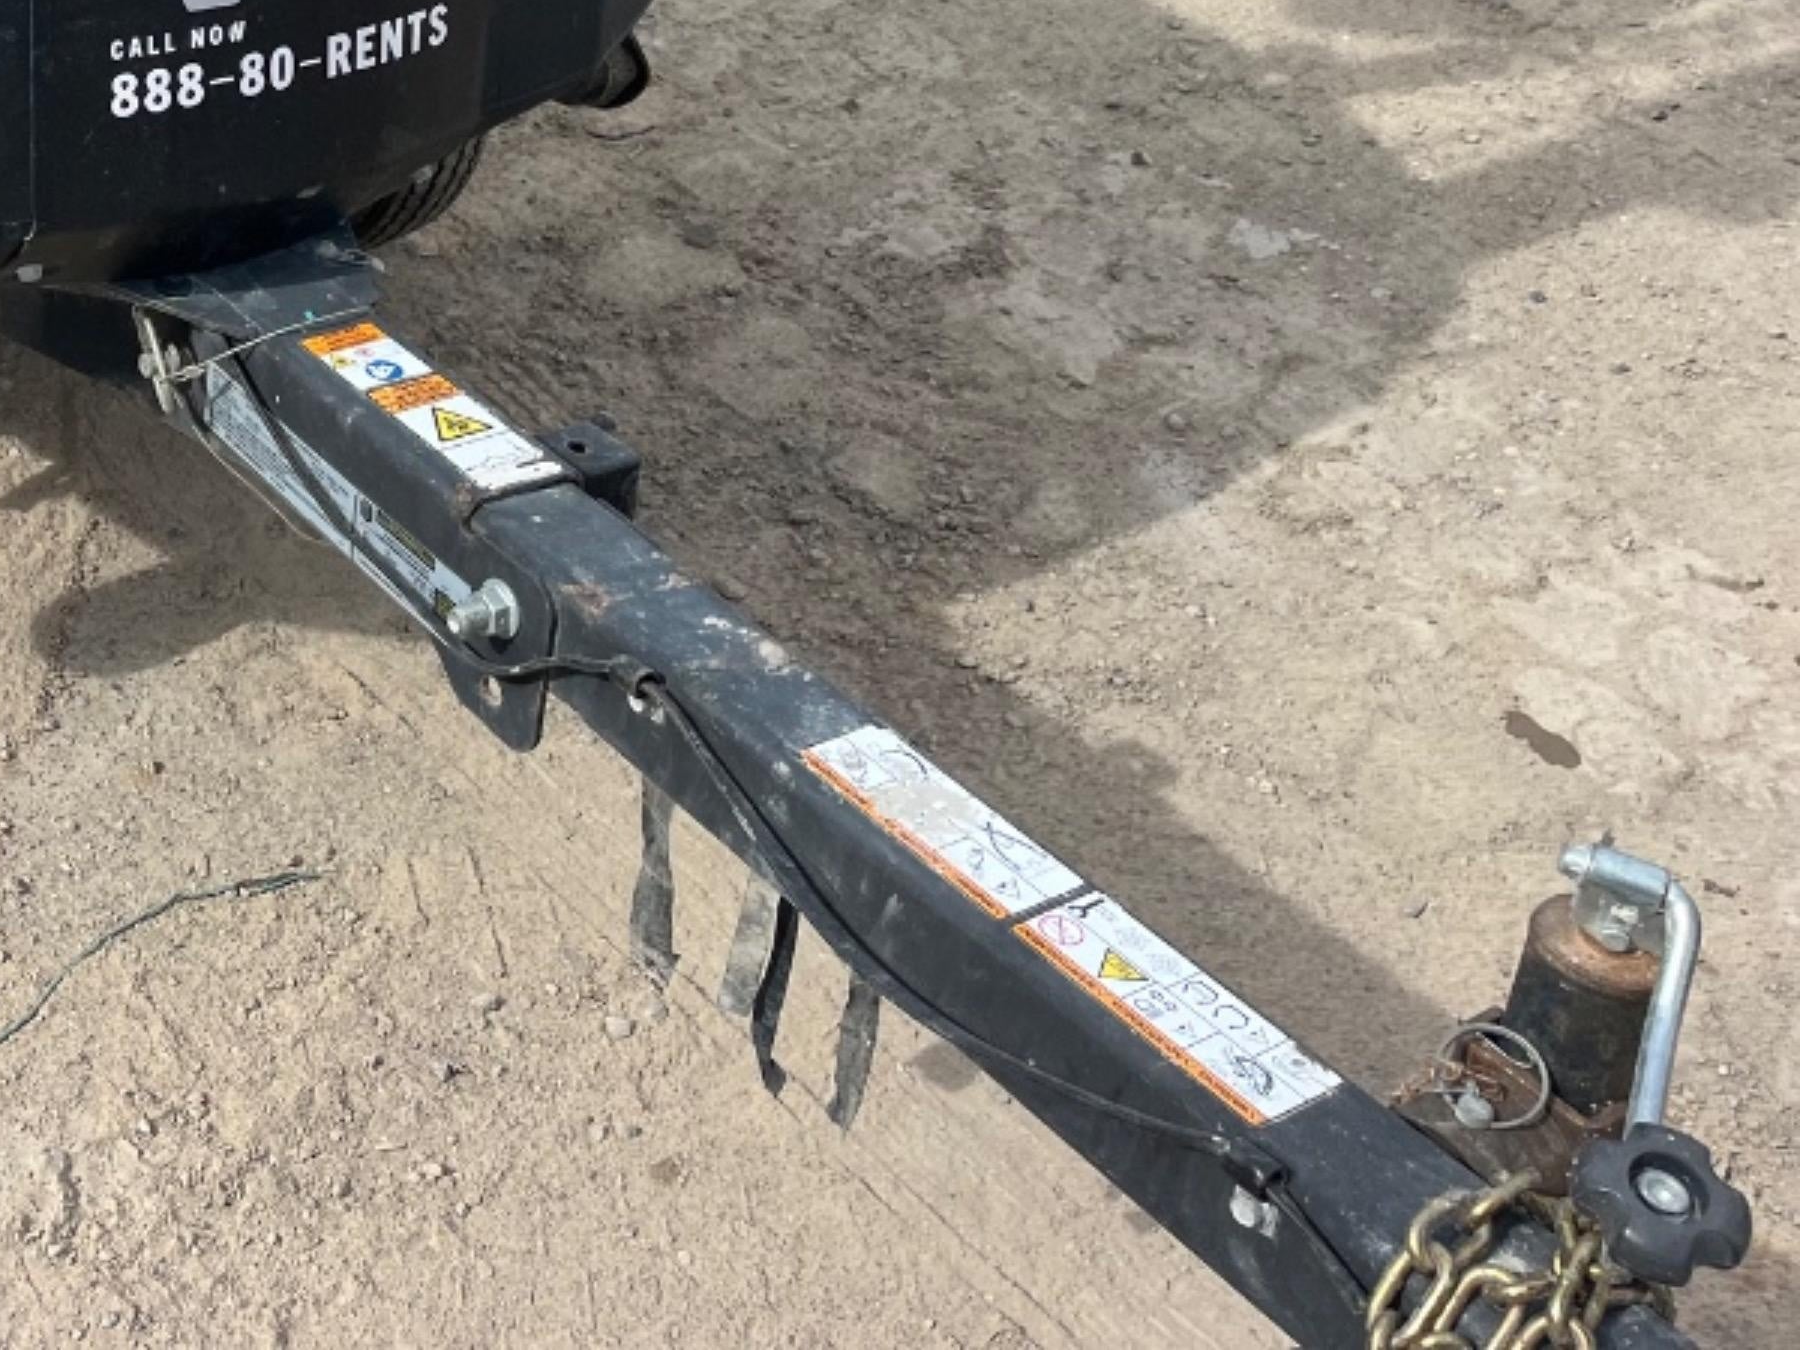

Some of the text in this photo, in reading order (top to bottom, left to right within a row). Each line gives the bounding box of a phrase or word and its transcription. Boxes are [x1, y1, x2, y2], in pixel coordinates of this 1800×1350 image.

[110, 20, 247, 61] CALL NOW
[110, 3, 449, 119] 888-80-RENTS
